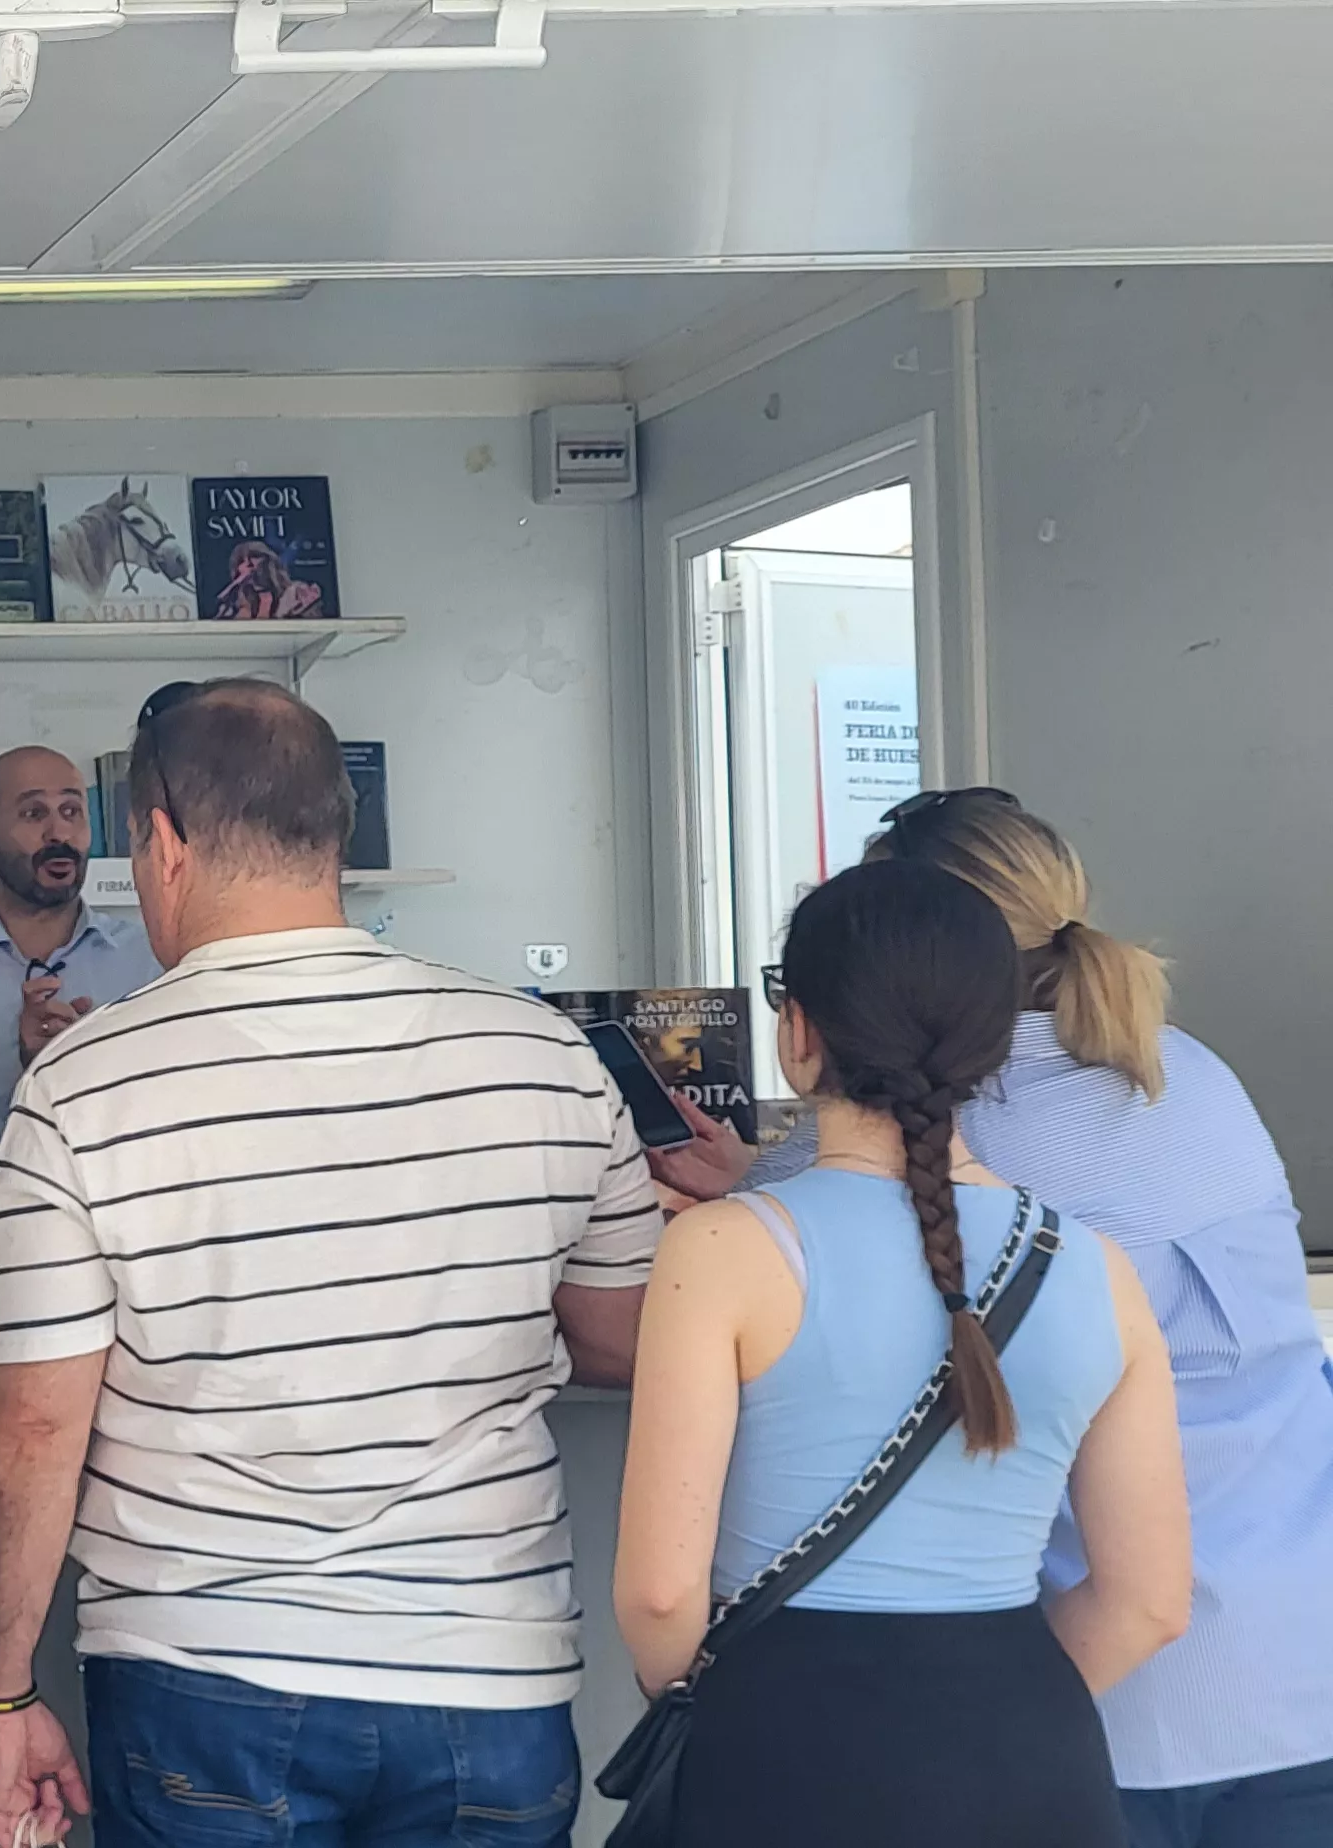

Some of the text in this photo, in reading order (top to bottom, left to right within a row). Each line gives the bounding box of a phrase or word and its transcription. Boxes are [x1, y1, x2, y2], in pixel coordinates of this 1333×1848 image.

[208, 487, 303, 509] TAYLOR
[207, 515, 285, 539] SWIFT
[844, 723, 898, 739] FERIA
[845, 746, 870, 762] DE
[633, 998, 725, 1014] SANTIAGO
[622, 1012, 738, 1029] POSTEGUILLO
[669, 1083, 749, 1107] DITA
